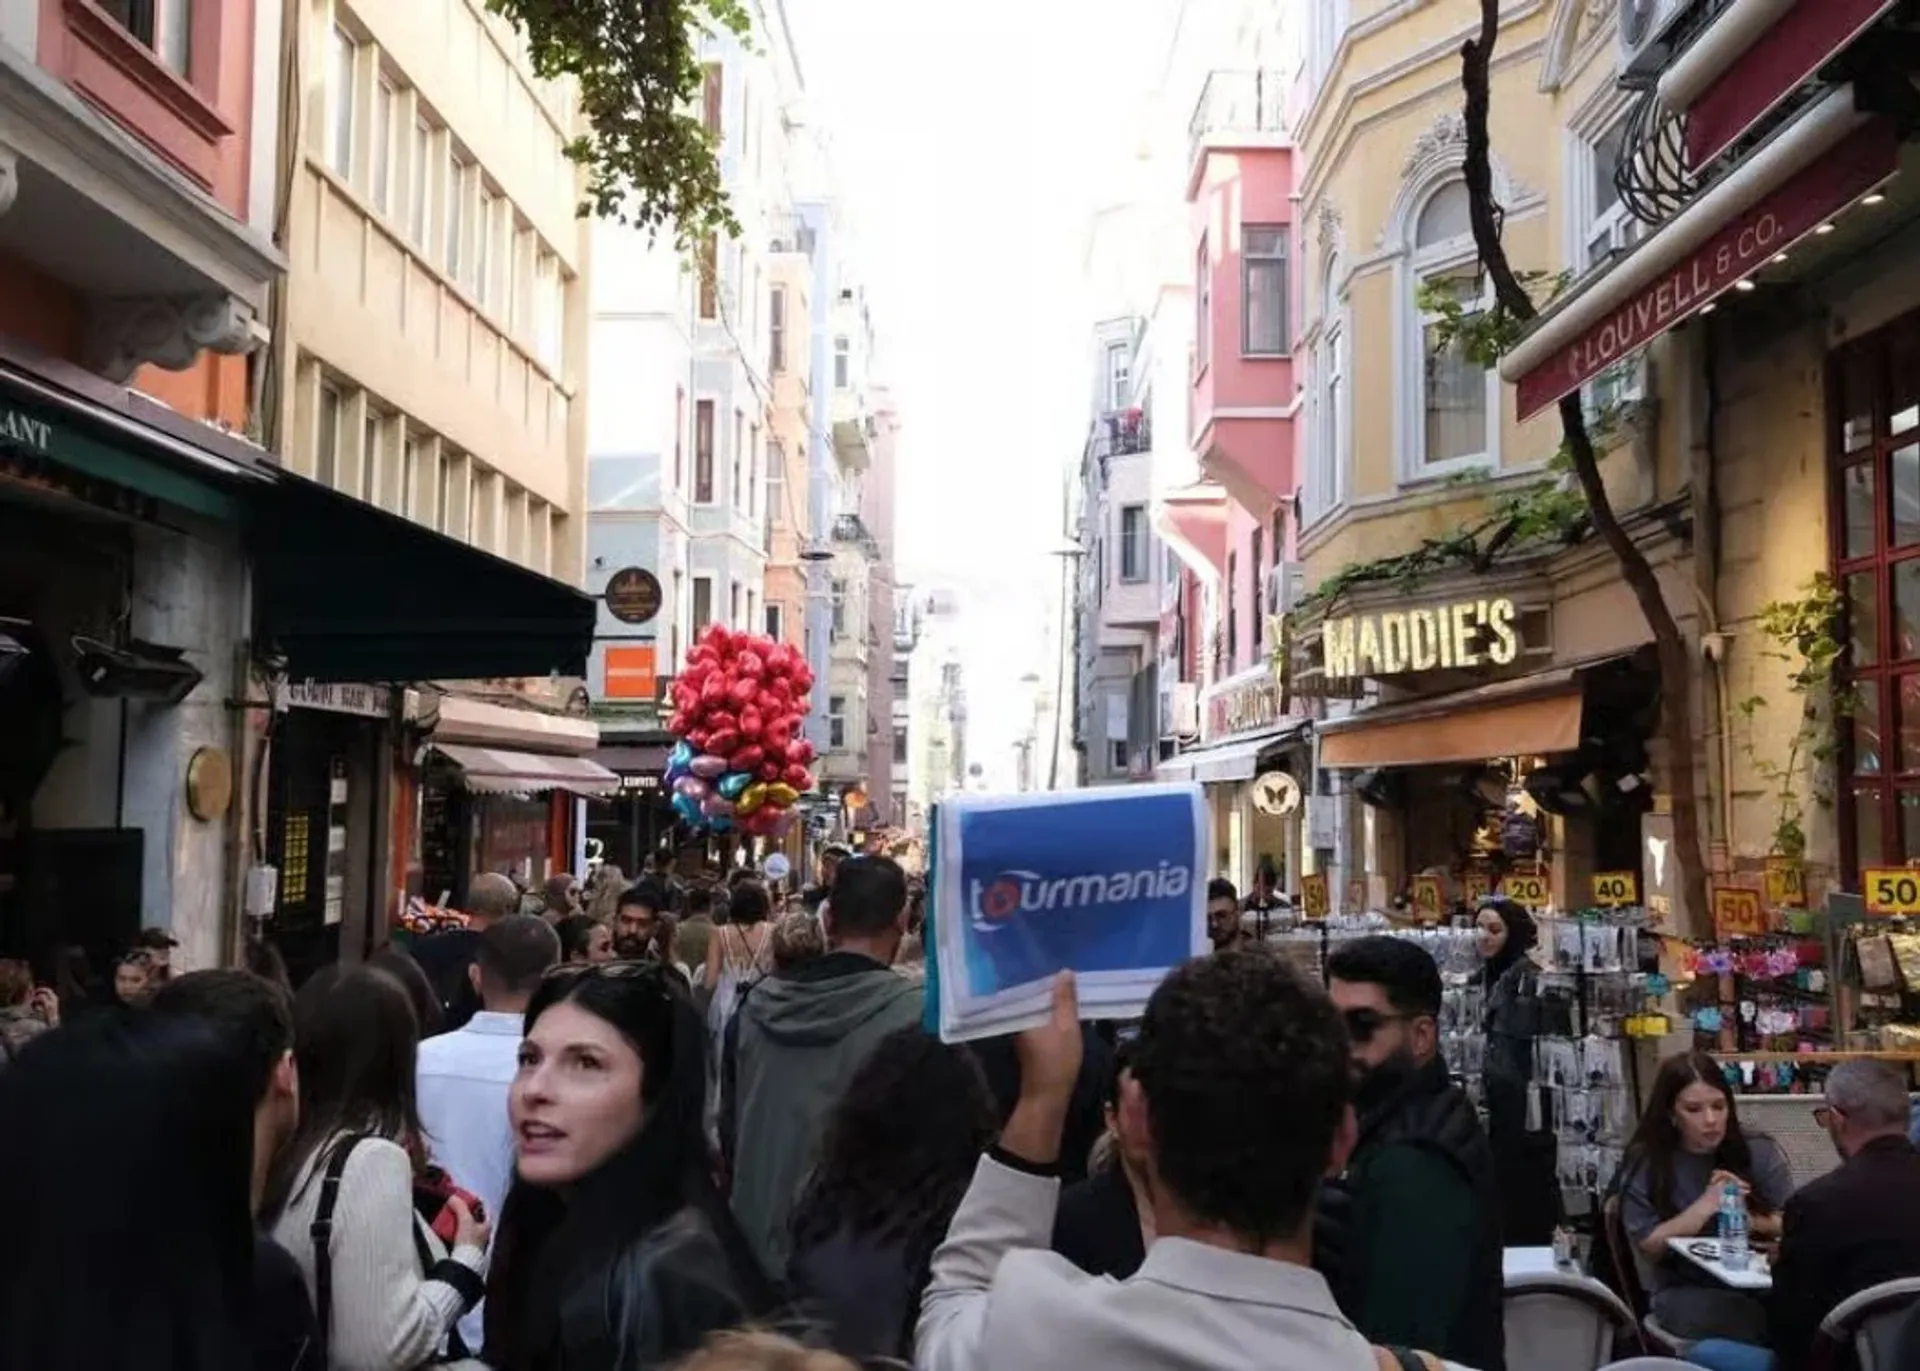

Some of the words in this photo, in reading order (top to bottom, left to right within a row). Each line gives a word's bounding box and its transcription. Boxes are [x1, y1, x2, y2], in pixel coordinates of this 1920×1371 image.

[1584, 260, 1711, 370] LOUVELL
[1716, 245, 1730, 274] &
[1738, 214, 1784, 259] CO.
[1322, 597, 1517, 678] MADDIE'S
[970, 860, 1190, 922] tourmania
[1511, 881, 1541, 899] 20
[1597, 879, 1626, 898] 40
[1877, 878, 1918, 905] 50
[1721, 899, 1754, 924] 50
